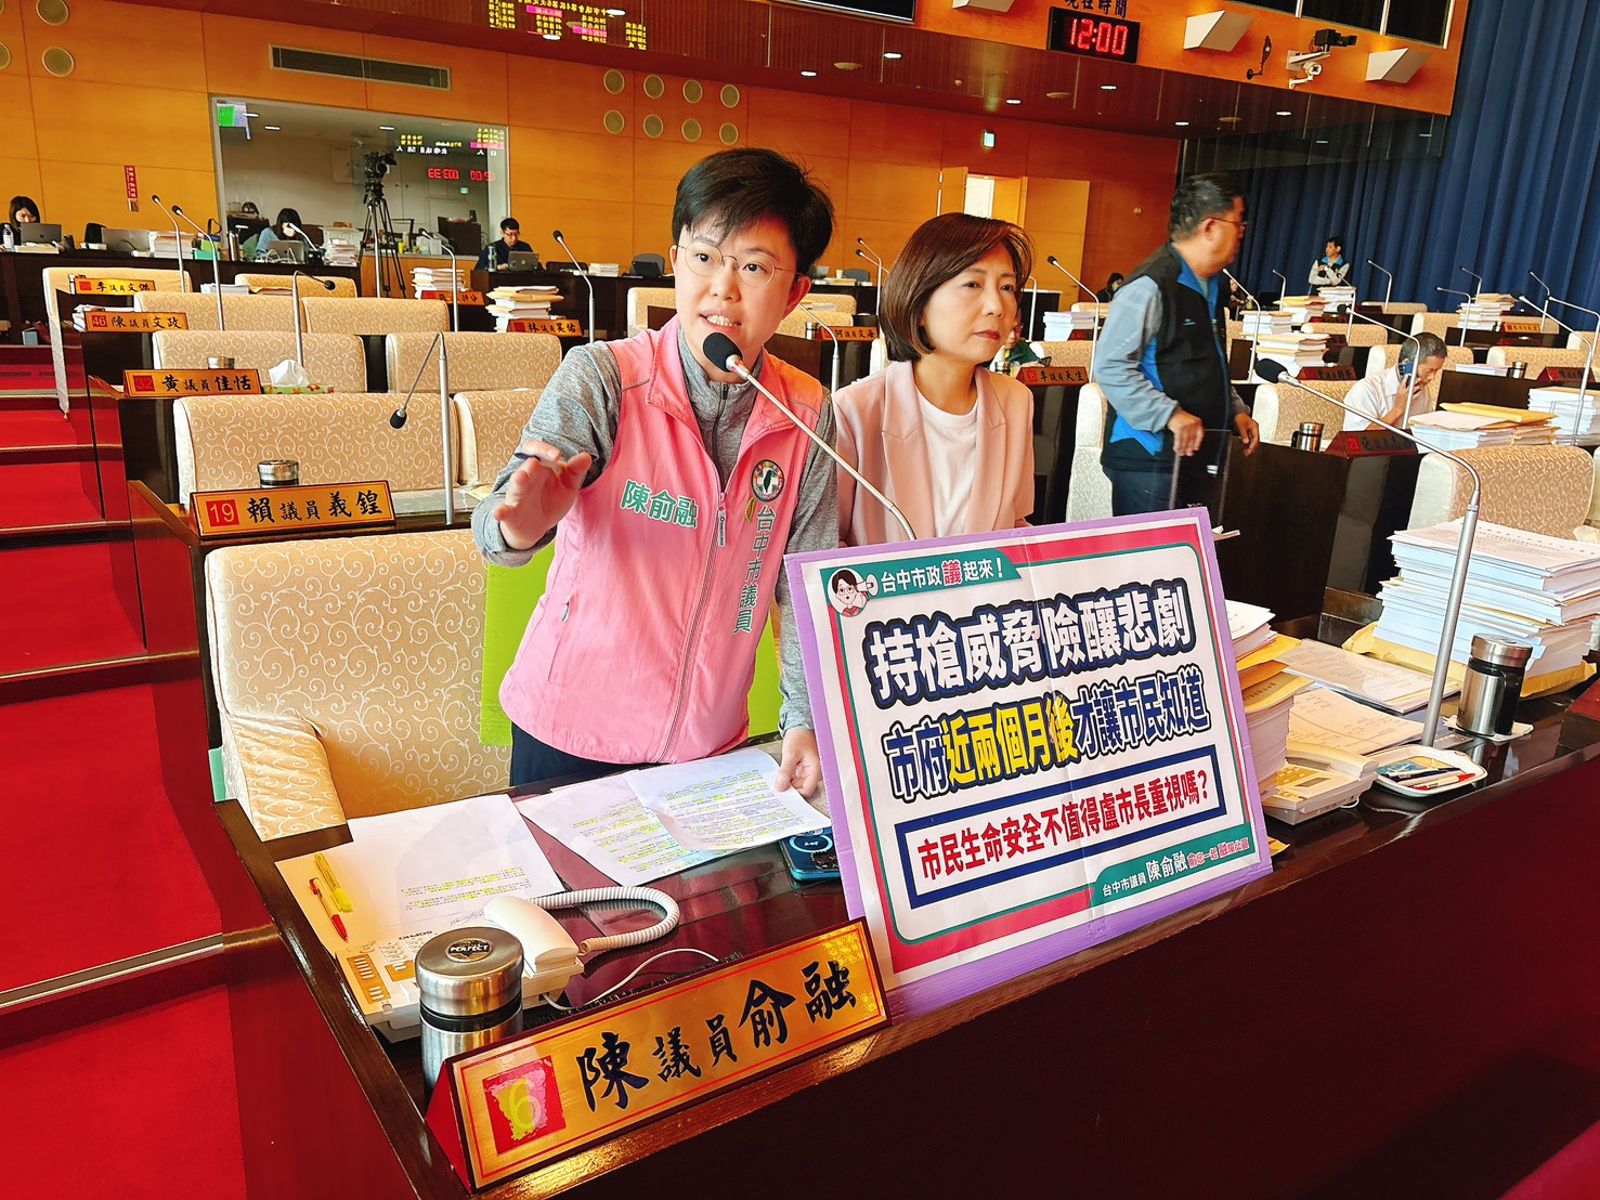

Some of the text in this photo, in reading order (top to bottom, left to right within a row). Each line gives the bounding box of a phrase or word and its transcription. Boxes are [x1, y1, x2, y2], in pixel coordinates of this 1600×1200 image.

[1071, 19, 1128, 55] 12:00
[92, 315, 182, 328] 46 陳議員文政
[162, 374, 251, 392] 黃議員佳恬
[210, 490, 383, 524] 19 賴議員義鍠
[620, 479, 699, 529] 陳俞融
[734, 505, 776, 634] 台中市議員
[867, 583, 1193, 705] 持槍威脅險釀悲劇
[885, 667, 1210, 798] 市府近兩個月後才讓市民知道
[918, 769, 1208, 880] 市民生命安全不值得盧市長重視嗎?
[1102, 872, 1147, 897] 台中市議員
[1146, 851, 1188, 882] 陳俞融
[509, 959, 857, 1131] 6 陳議員俞融
